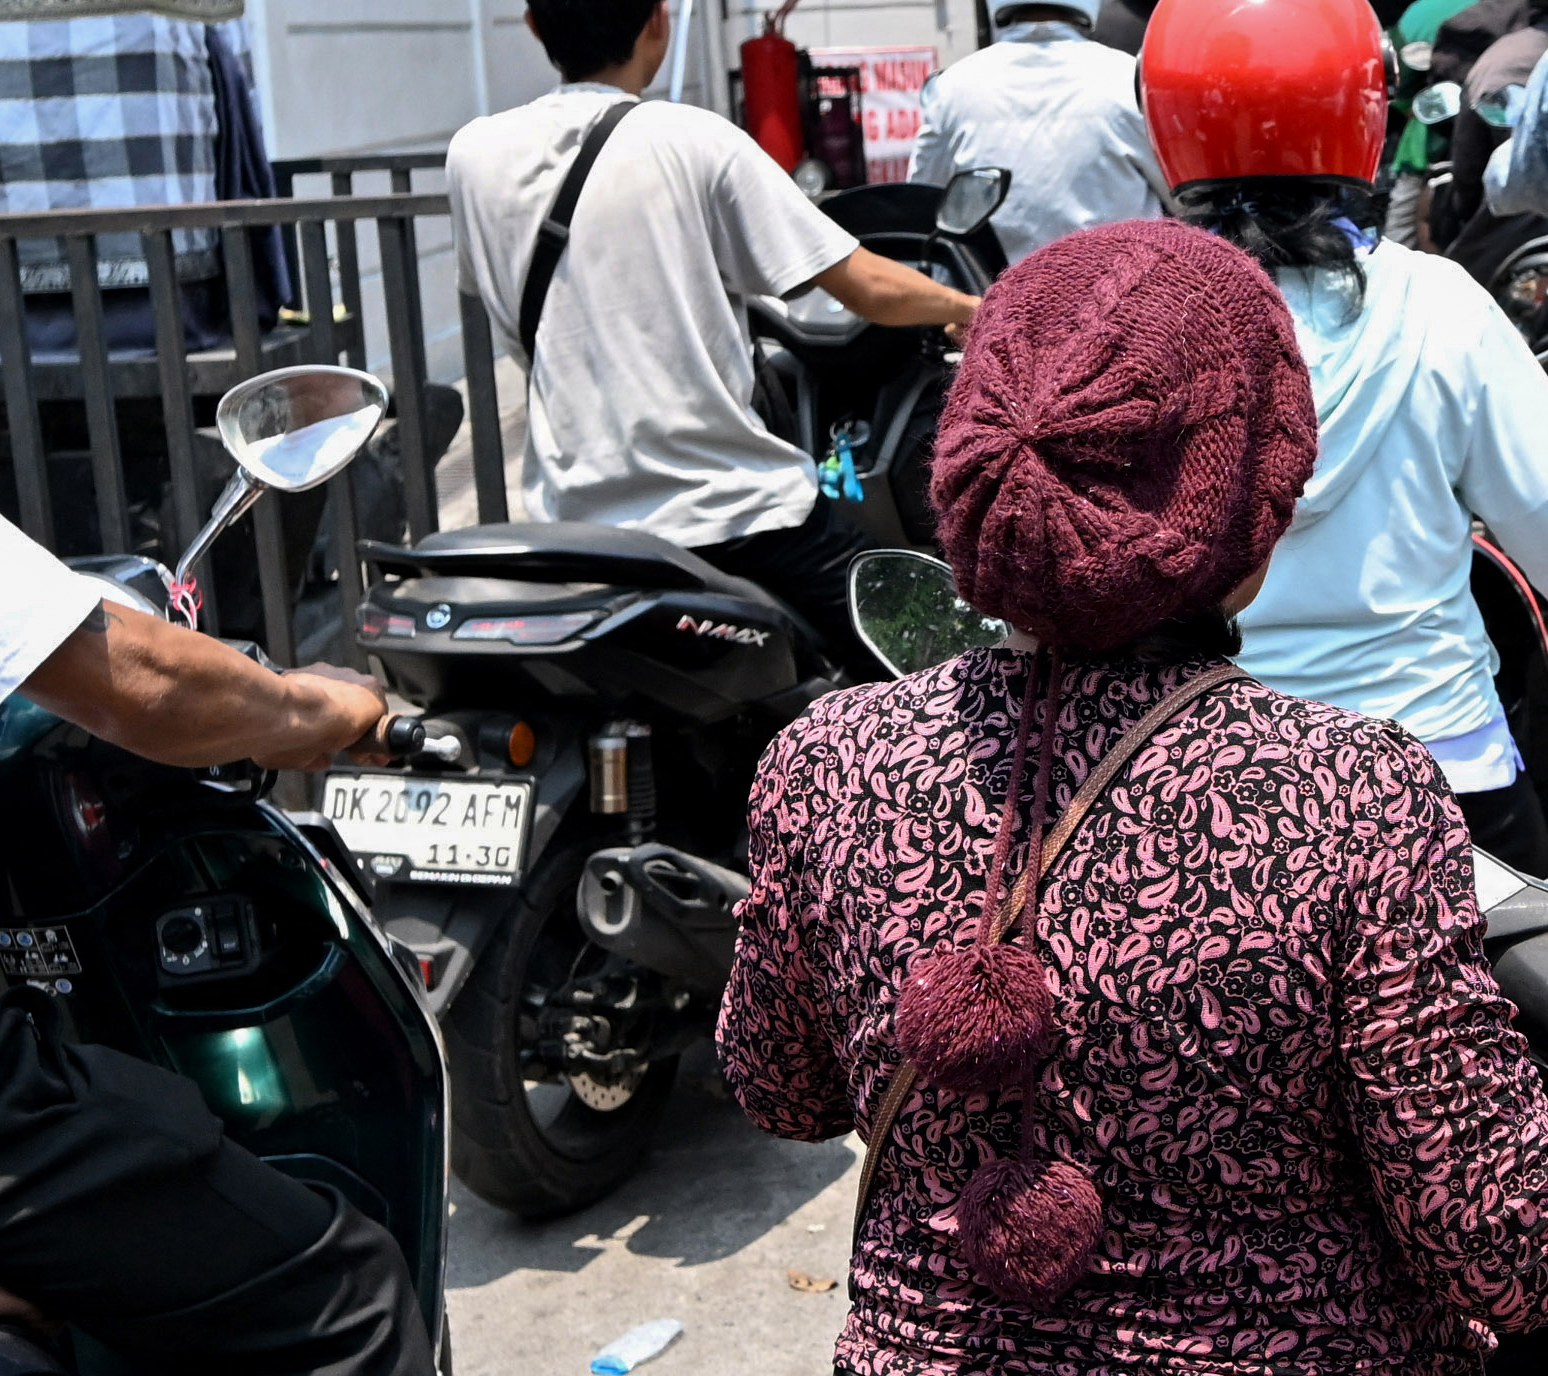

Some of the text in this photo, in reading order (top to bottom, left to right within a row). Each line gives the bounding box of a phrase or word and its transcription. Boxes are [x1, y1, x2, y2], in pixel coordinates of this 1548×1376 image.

[675, 614, 771, 647] NMAX
[331, 786, 522, 829] DK 2092 AFM
